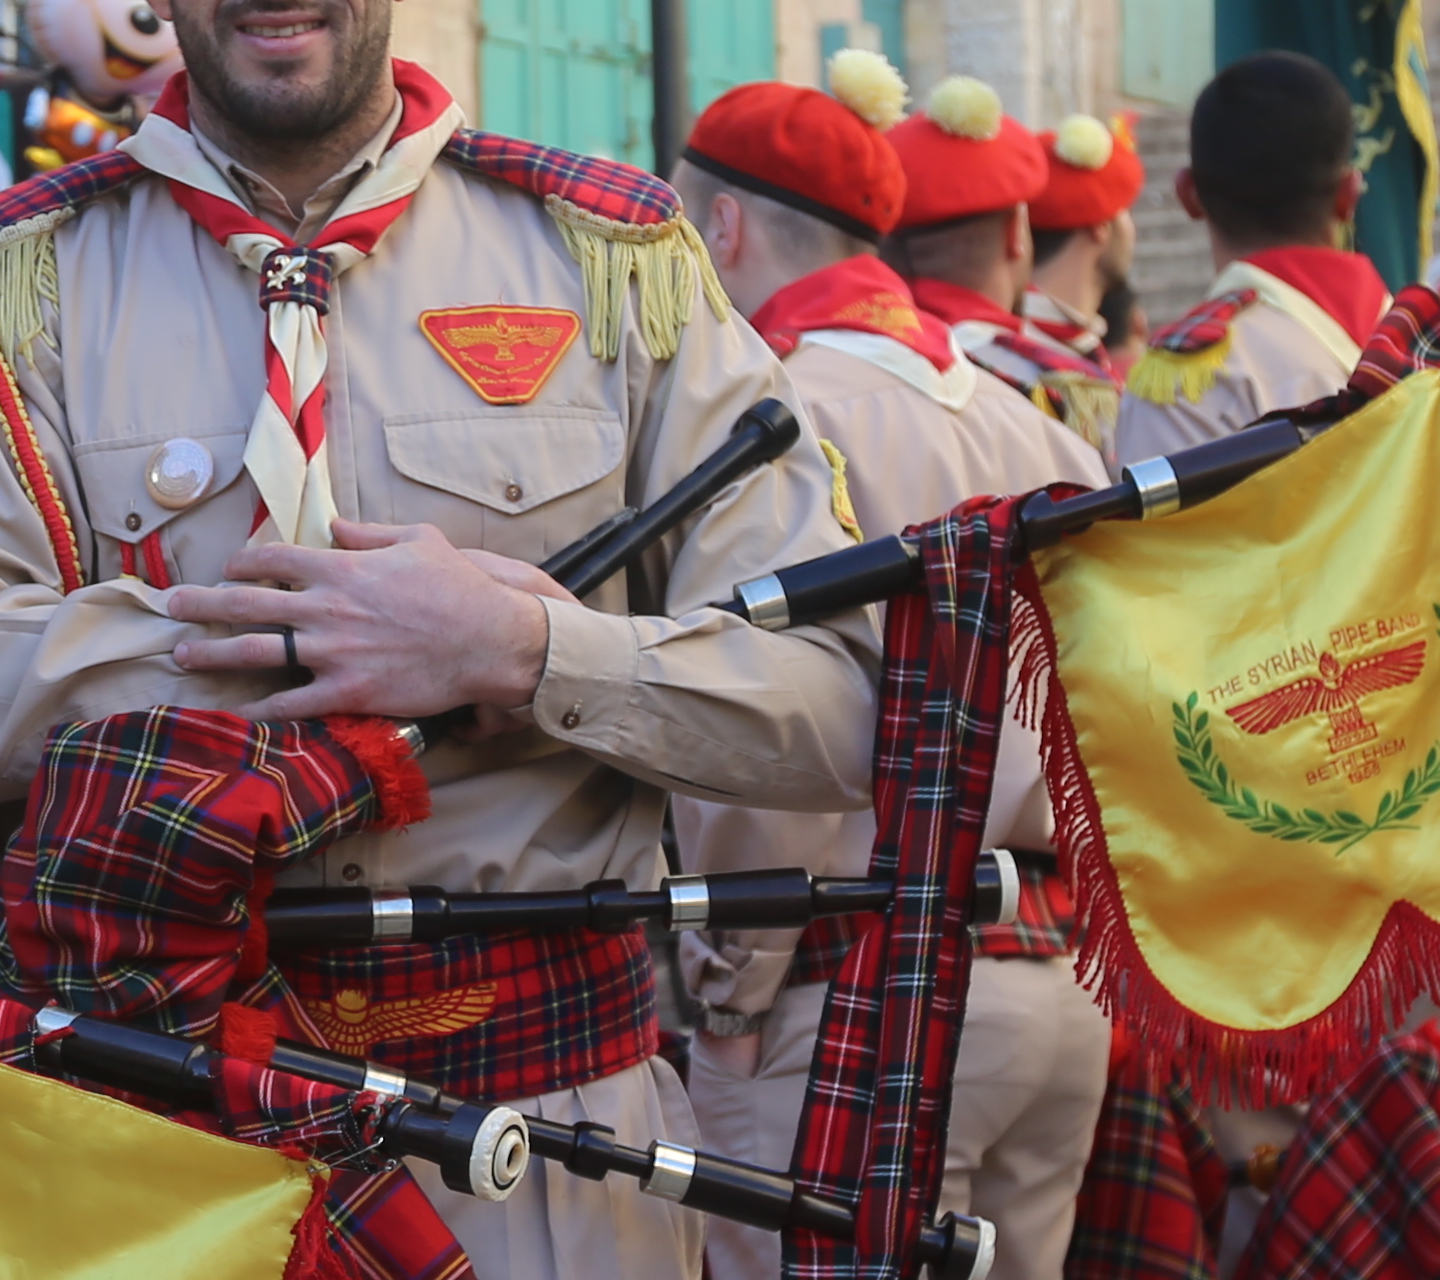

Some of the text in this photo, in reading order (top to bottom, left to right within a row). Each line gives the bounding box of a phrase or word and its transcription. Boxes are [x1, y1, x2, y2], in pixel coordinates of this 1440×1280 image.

[1208, 613, 1422, 704] THE SYRIAN PIPE BAND
[1306, 738, 1407, 786] BETHLEHEM
